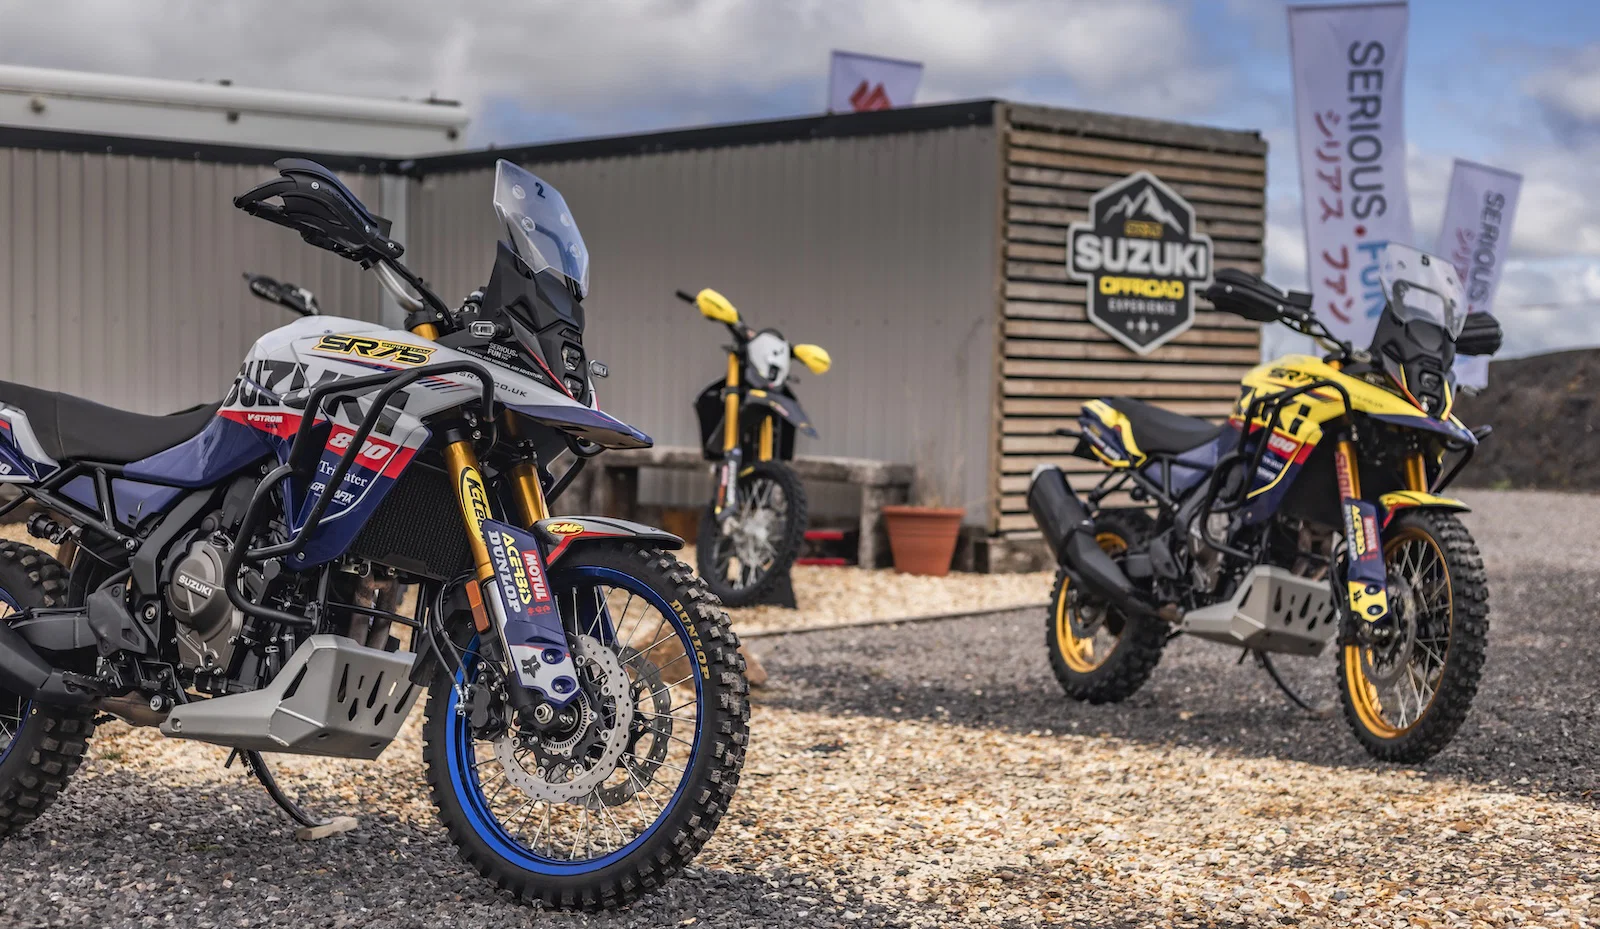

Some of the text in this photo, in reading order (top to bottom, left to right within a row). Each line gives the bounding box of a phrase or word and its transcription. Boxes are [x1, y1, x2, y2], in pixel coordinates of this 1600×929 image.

[535, 181, 546, 199] 2
[1074, 234, 1207, 278] SUZUKI
[1099, 276, 1185, 299] OFFROAD
[318, 334, 430, 365] SR75
[247, 413, 283, 423] V-STROM
[547, 523, 584, 535] FMF
[178, 574, 212, 597] SUZUKI
[488, 531, 521, 613] DUNLOP
[524, 552, 548, 600] MOTUL
[669, 599, 710, 680] DUNLOP
